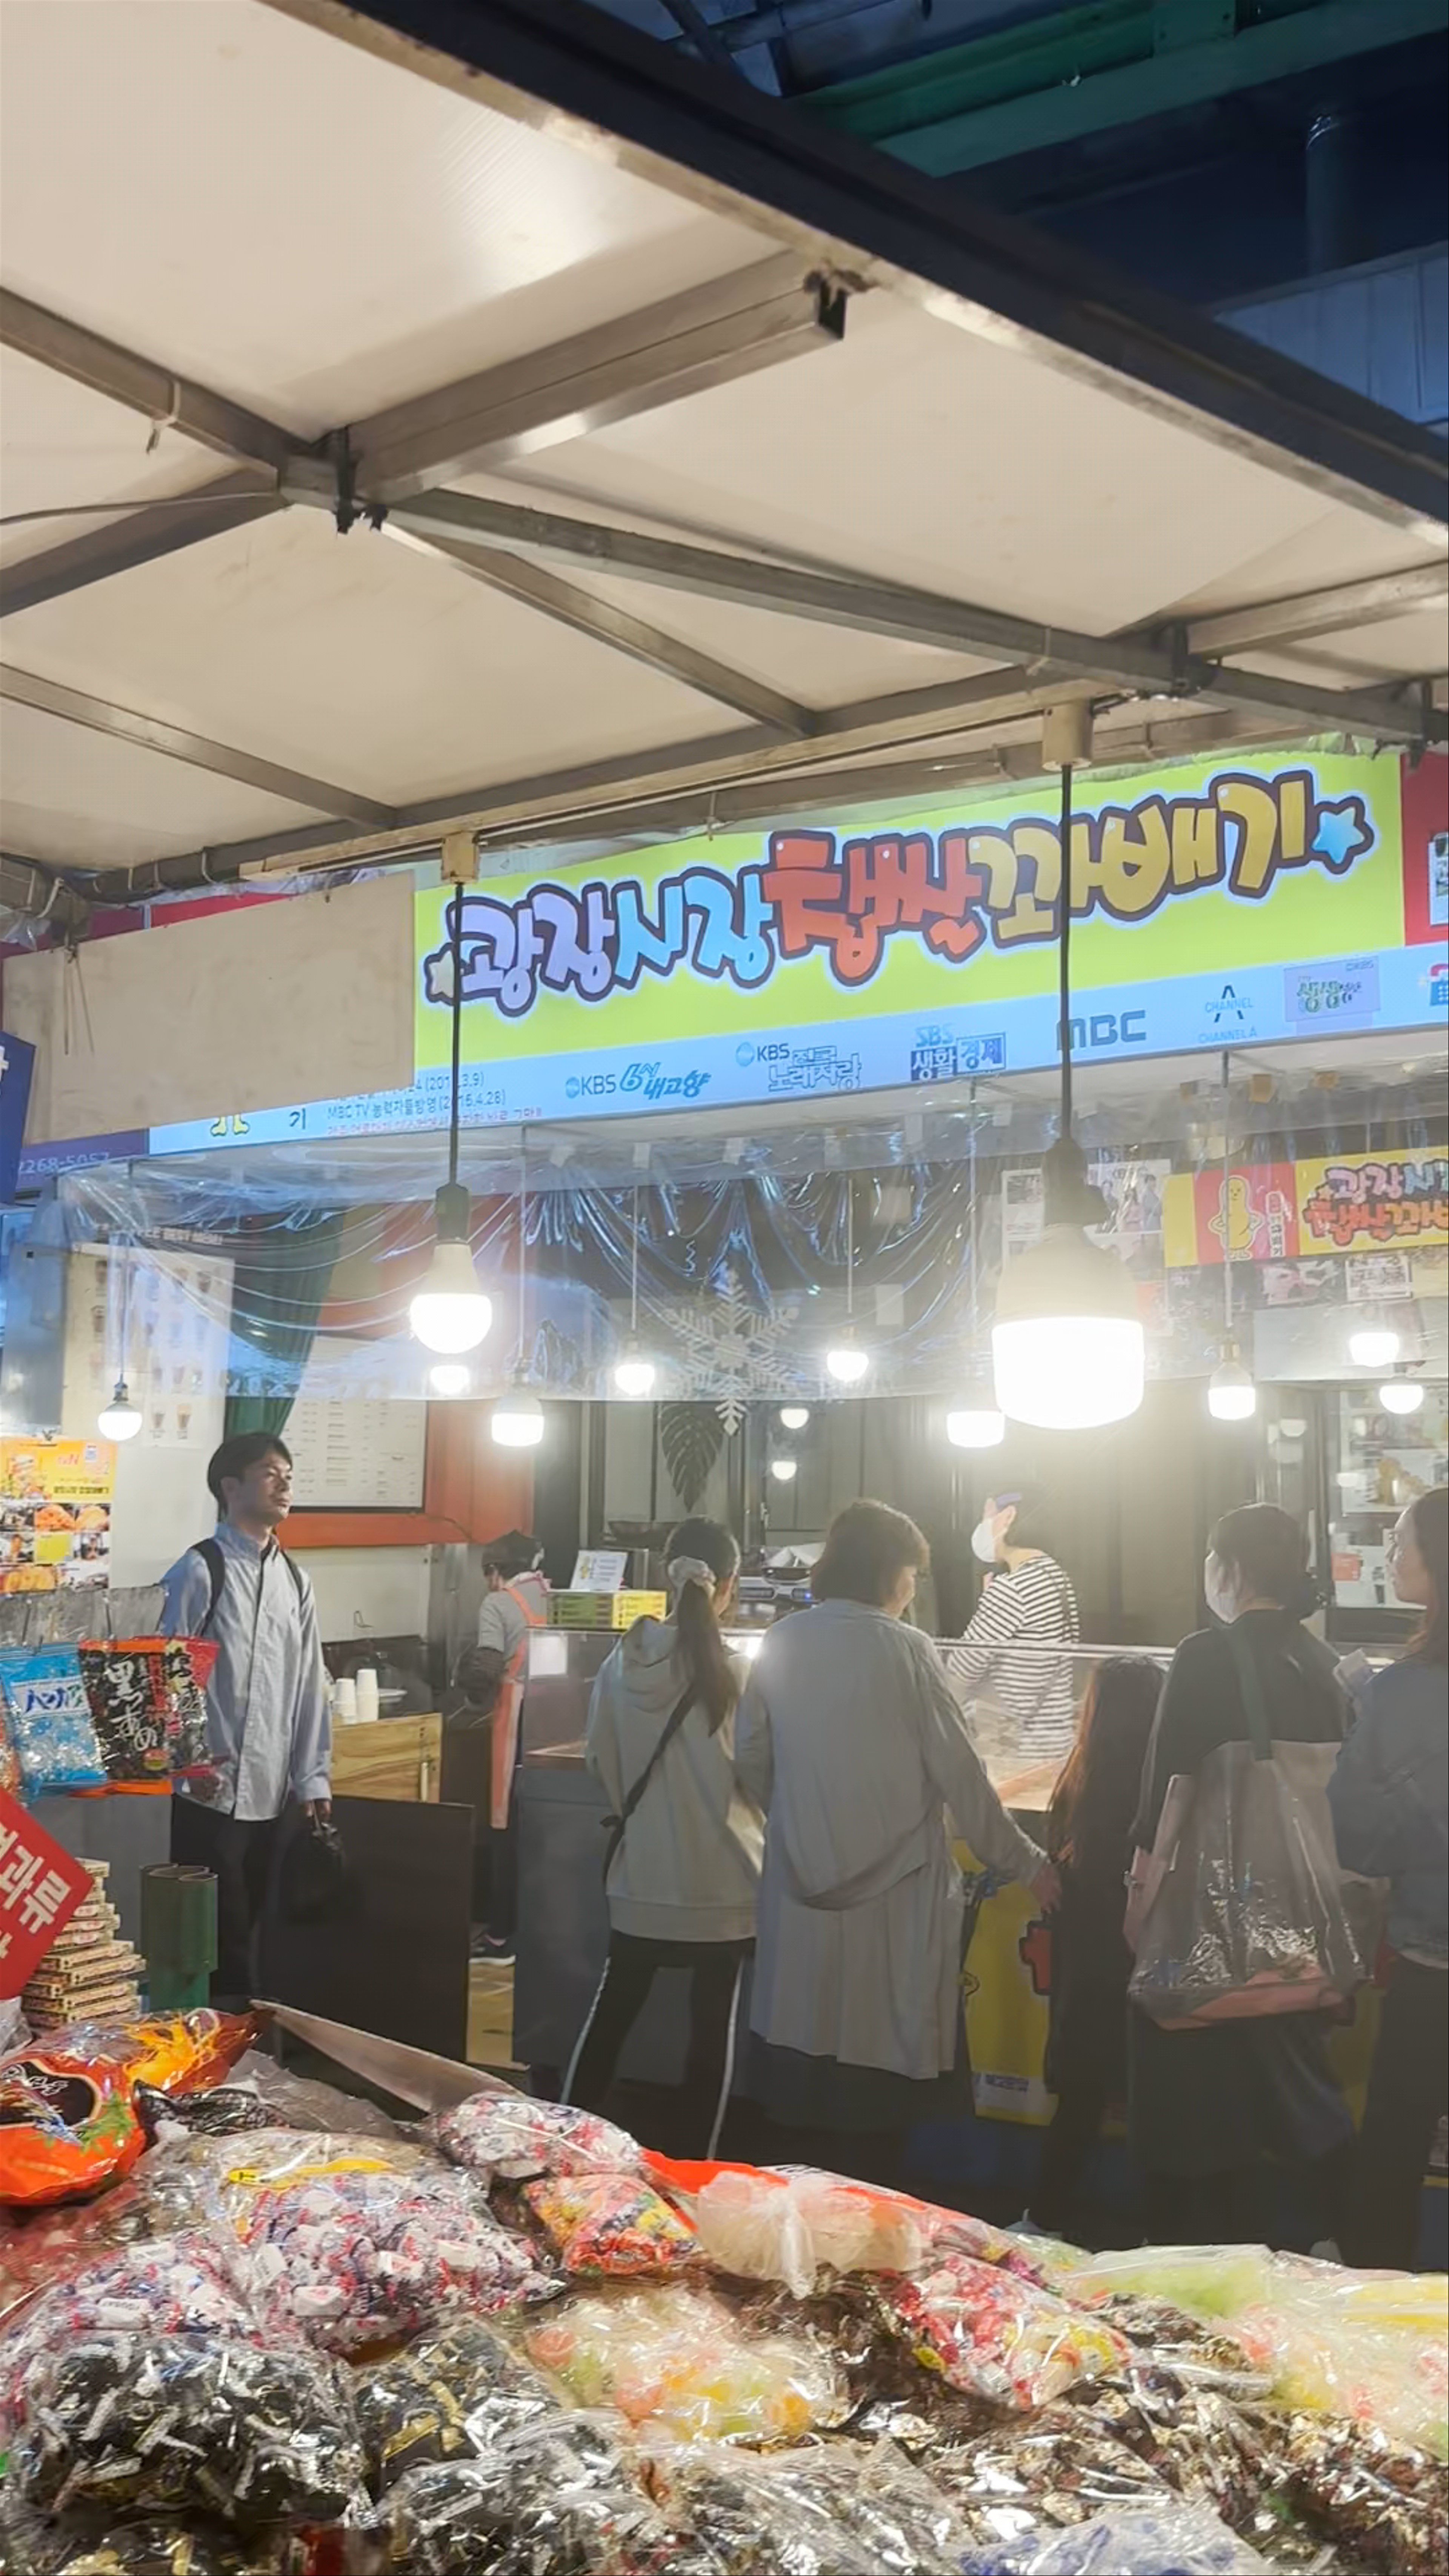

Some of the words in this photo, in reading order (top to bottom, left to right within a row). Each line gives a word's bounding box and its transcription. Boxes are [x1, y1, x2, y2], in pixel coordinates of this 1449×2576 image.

[915, 1023, 953, 1047] SBS
[1057, 1010, 1146, 1050] MBC
[757, 1043, 790, 1062] KBS
[581, 1073, 616, 1095] KBS
[768, 1053, 863, 1092] 노래자랑
